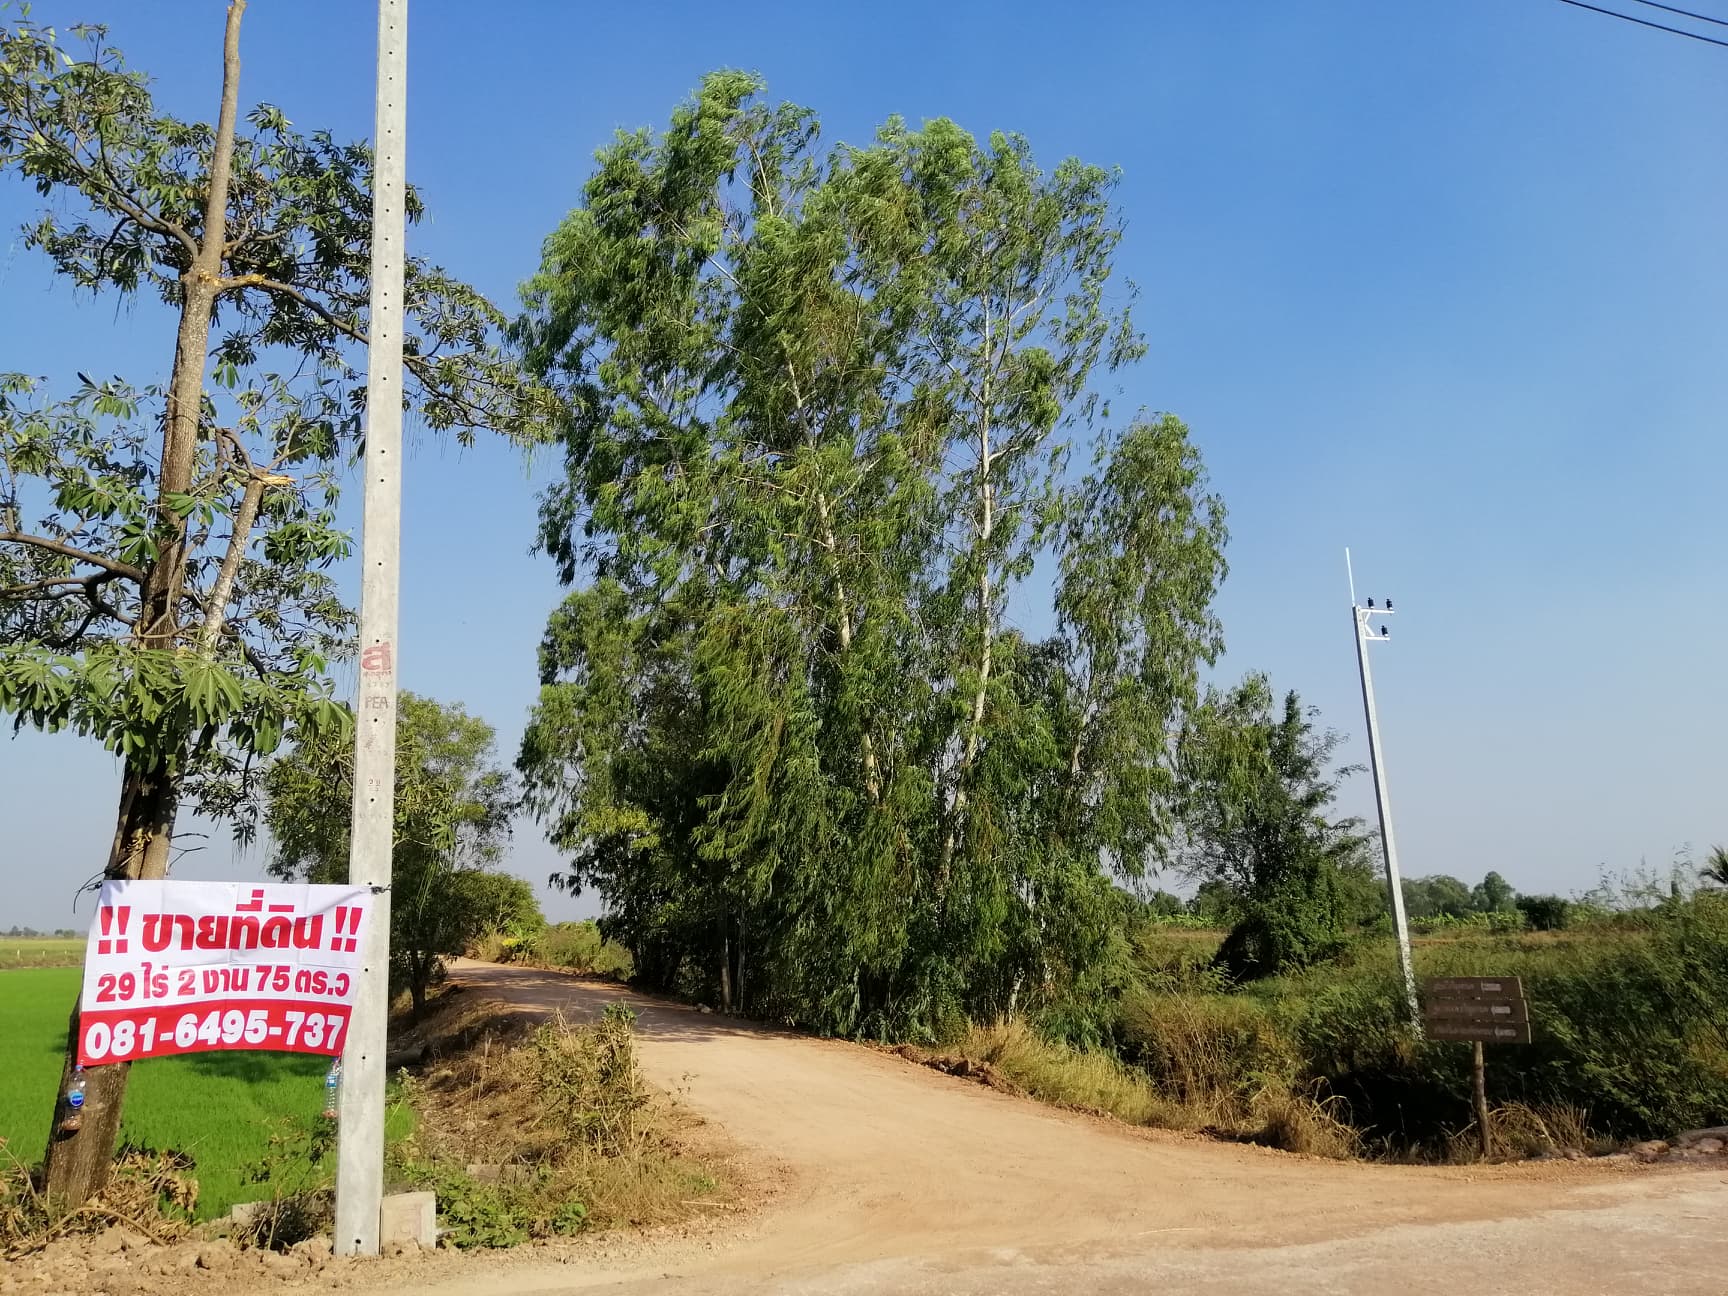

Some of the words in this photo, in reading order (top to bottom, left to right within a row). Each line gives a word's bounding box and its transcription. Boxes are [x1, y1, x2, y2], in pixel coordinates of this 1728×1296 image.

[365, 696, 388, 710] PEA
[141, 889, 324, 950] ขายที่ดิน
[96, 972, 136, 1003] 29
[141, 962, 169, 999] ไร่
[177, 969, 196, 996] 2
[203, 968, 250, 994] งาน
[256, 965, 291, 992] 75
[295, 969, 350, 997] ตร.ว
[85, 1009, 345, 1059] 081-6495-737
